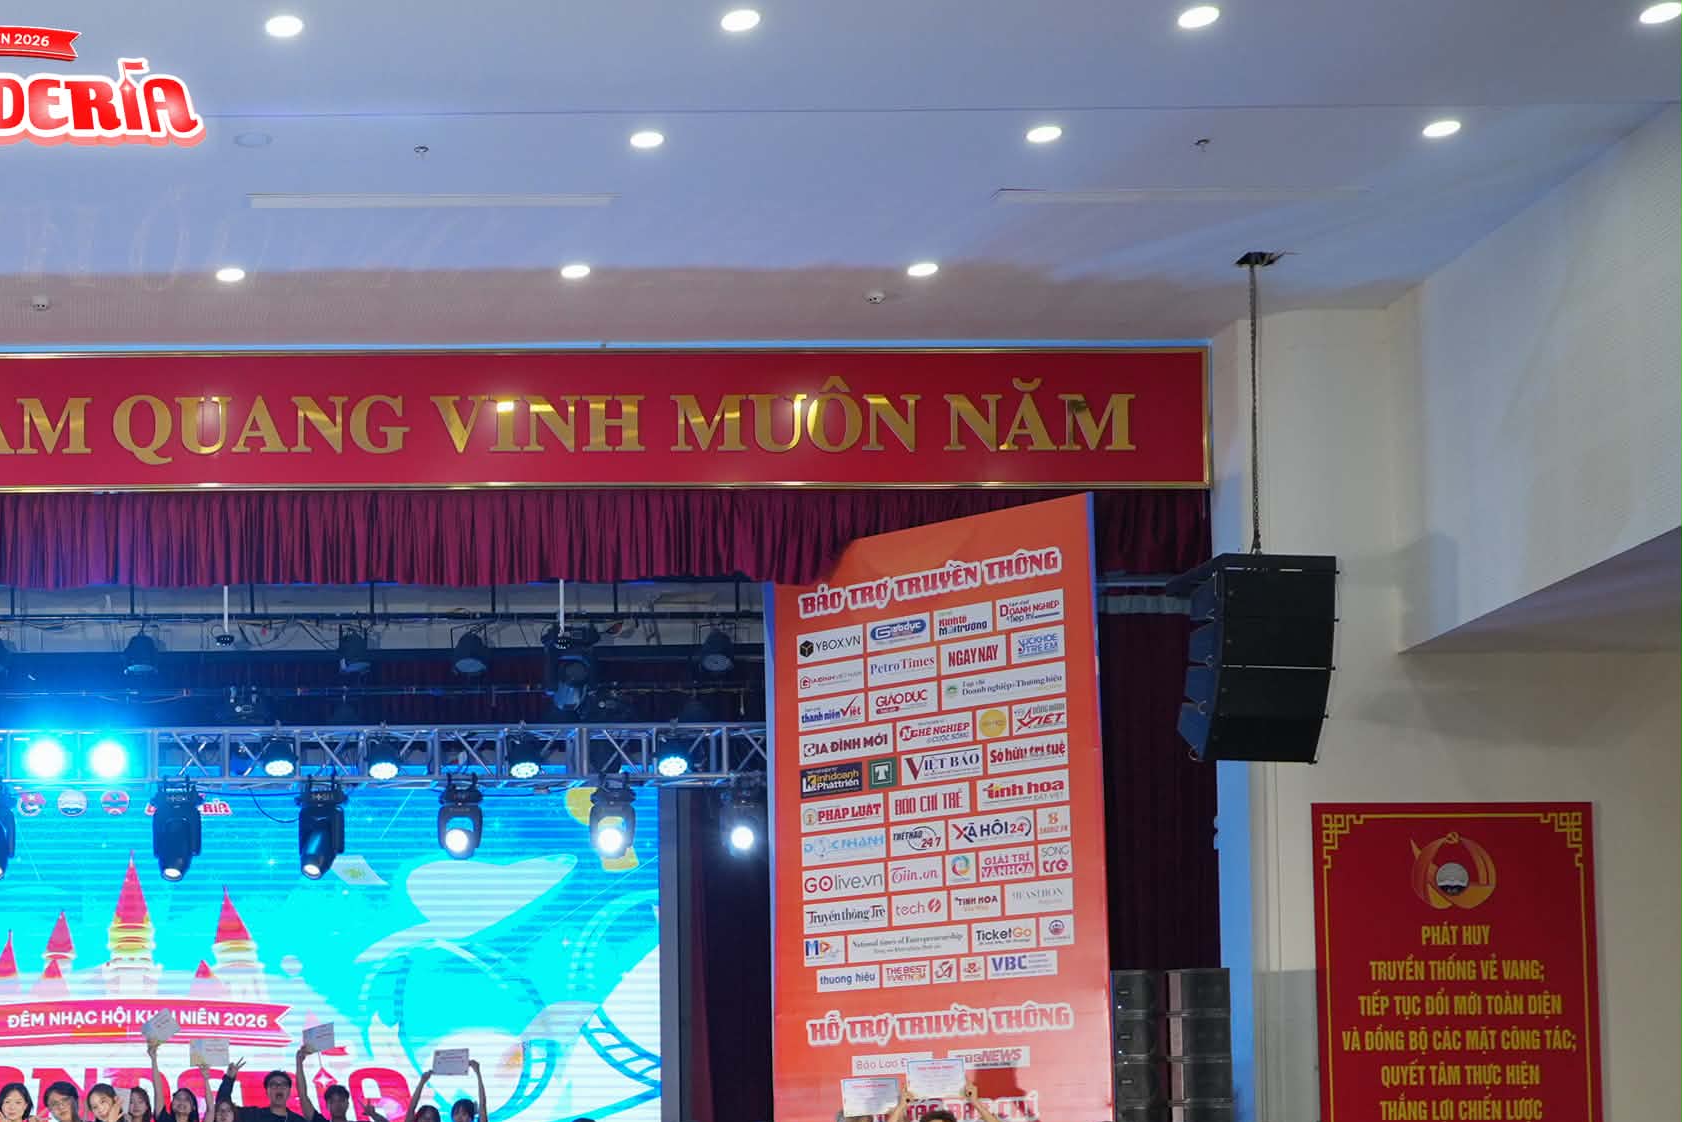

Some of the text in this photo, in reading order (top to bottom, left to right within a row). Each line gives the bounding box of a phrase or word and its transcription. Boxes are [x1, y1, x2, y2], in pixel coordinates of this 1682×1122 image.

[114, 395, 411, 467] QUANG
[433, 395, 645, 453] VINH
[671, 376, 923, 454] MUÔN
[944, 377, 1136, 453] NĂM
[985, 548, 1059, 581] THÔNG
[1027, 780, 1065, 795] hoa
[895, 901, 926, 916] tech
[976, 927, 1032, 941] TicketGo
[1421, 921, 1491, 946] PHÁT HUY
[1428, 952, 1477, 981] THỐNG
[7, 1006, 268, 1029] ĐÊM NHẠC HỘI KHI NIÊN 2026
[1358, 989, 1391, 1017] TIẾP
[1394, 995, 1421, 1021] TỤC
[1454, 991, 1482, 1016] MỚI
[1486, 990, 1524, 1016] TOÀN
[1528, 990, 1563, 1020] DIỆN
[1341, 1026, 1361, 1051] VÀ
[1408, 1026, 1428, 1056] BỘ
[1432, 1025, 1462, 1051] CÁC
[1501, 1025, 1541, 1050] CÔNG
